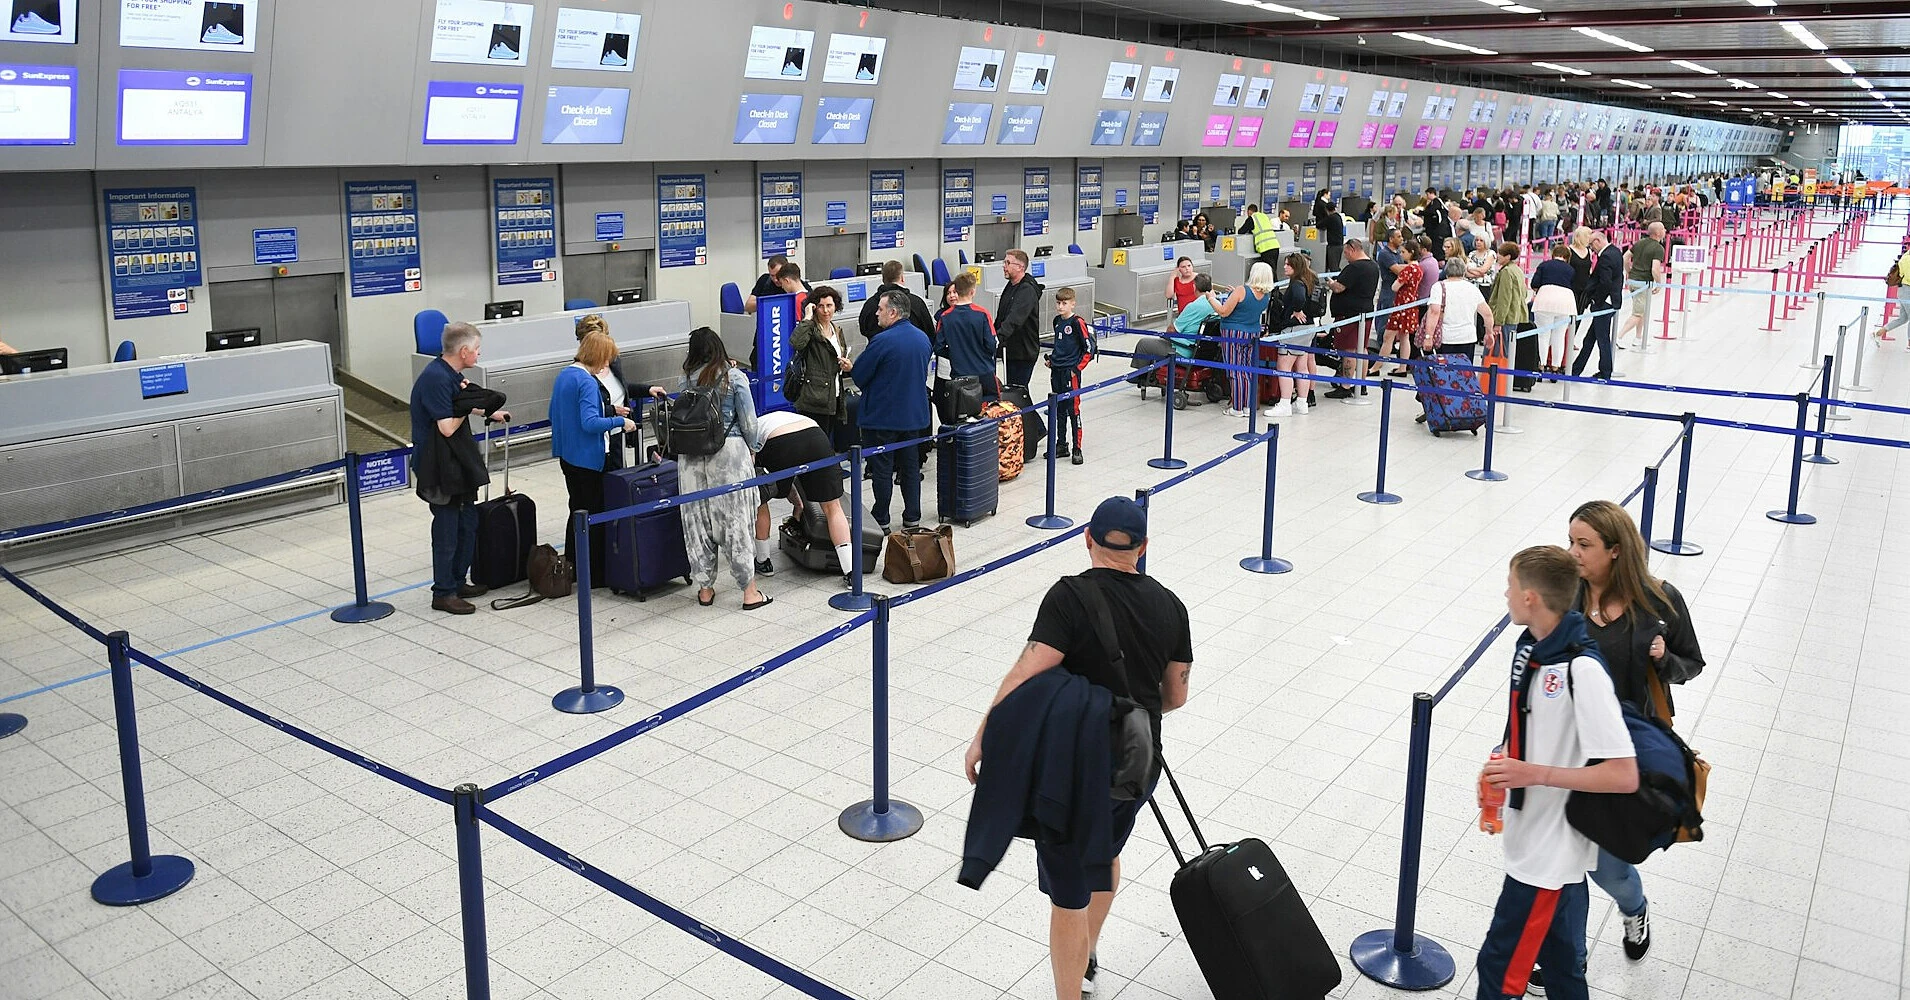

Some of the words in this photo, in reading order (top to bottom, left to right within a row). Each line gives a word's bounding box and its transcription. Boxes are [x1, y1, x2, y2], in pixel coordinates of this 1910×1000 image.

[784, 3, 793, 20] 6
[860, 11, 869, 28] 7
[22, 72, 70, 80] SunExpress
[594, 106, 612, 115] Desk
[775, 111, 788, 119] Desk
[574, 117, 598, 126] Closed
[758, 120, 778, 128] Closed
[110, 193, 146, 201] Important
[366, 458, 393, 467] NOTICE
